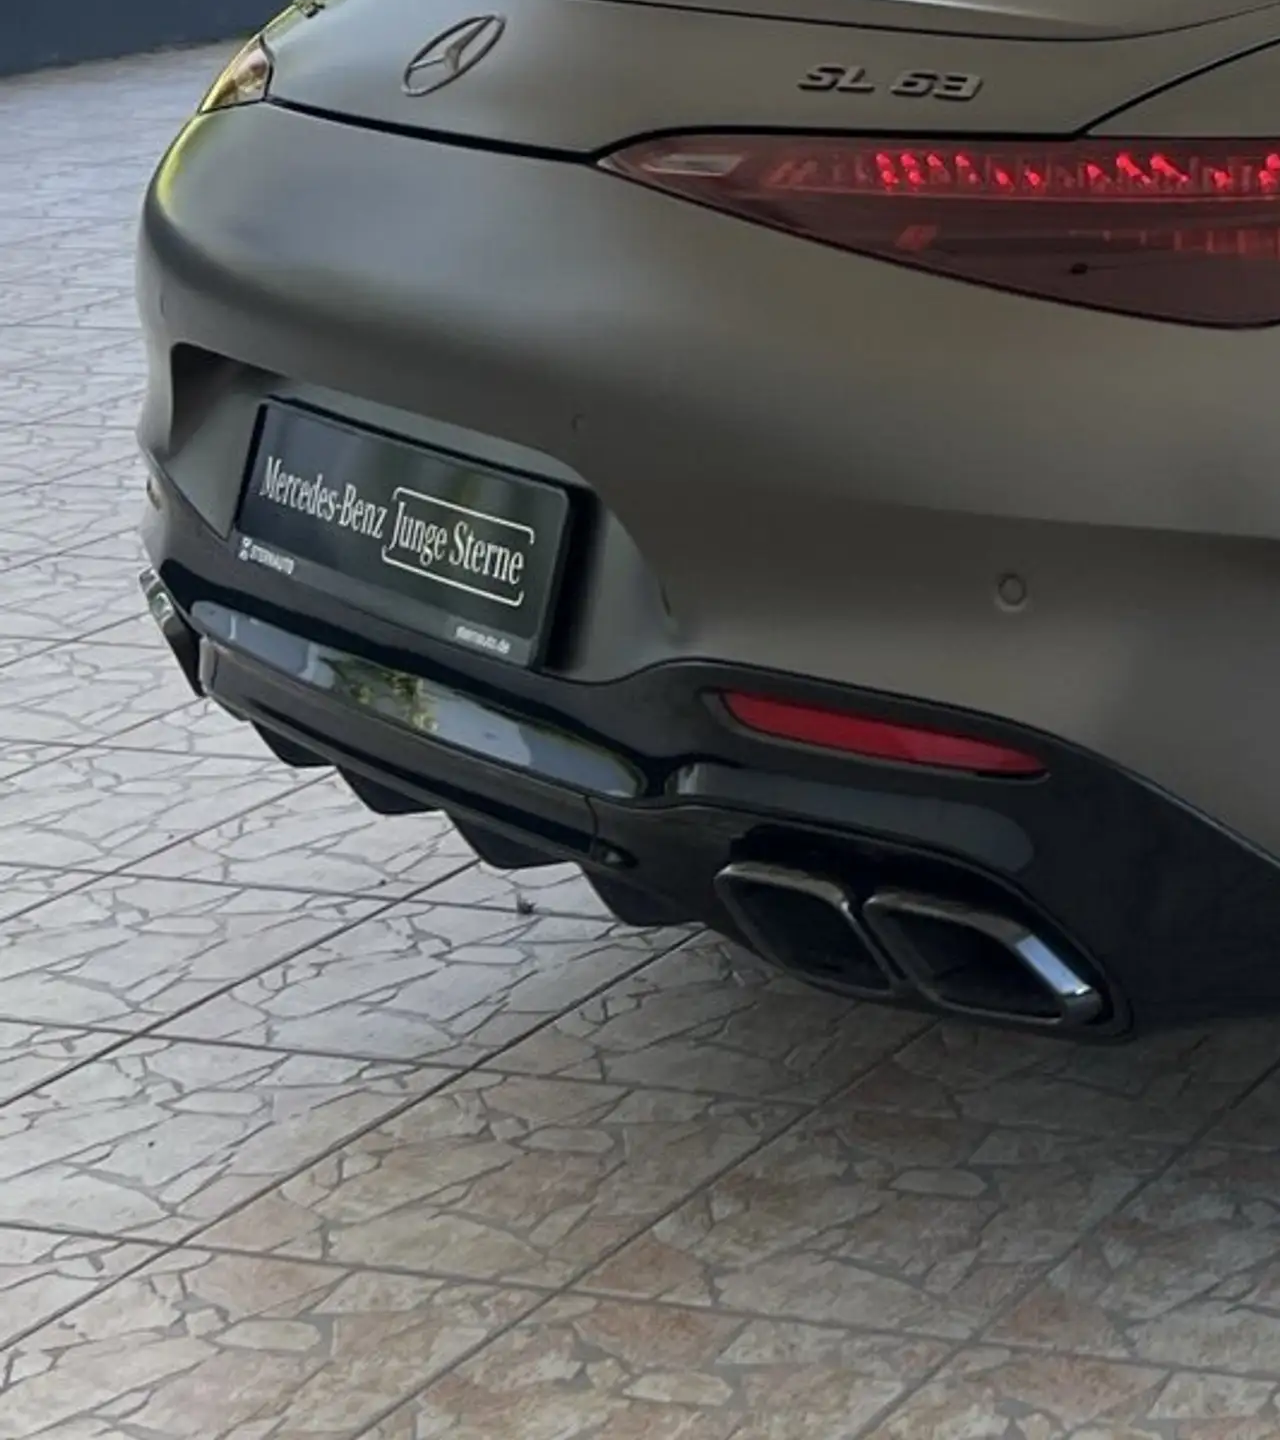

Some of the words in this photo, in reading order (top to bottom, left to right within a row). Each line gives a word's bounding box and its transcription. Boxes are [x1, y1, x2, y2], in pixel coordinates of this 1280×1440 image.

[797, 61, 876, 93] SL
[889, 68, 984, 102] 63
[259, 456, 389, 539] Mercedes-Benz
[388, 501, 449, 566] Junge
[449, 520, 525, 585] Sterne
